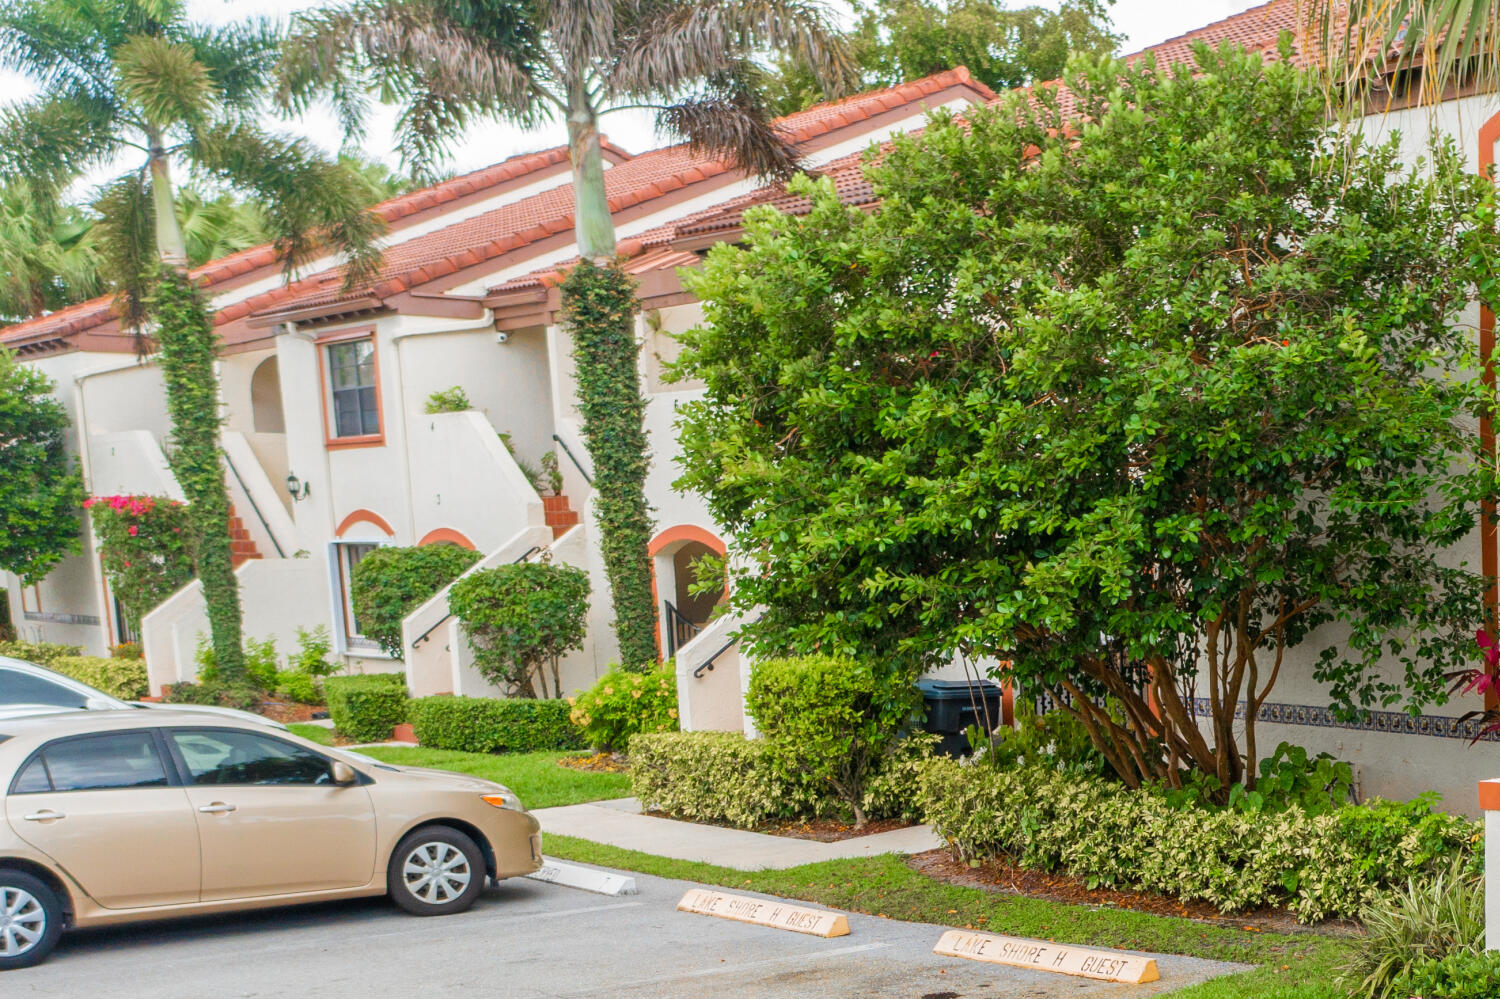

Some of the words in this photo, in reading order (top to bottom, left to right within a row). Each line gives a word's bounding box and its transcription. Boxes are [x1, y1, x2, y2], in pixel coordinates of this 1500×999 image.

[692, 894, 722, 912] LAKE
[729, 900, 763, 919] SHORE
[770, 907, 782, 921] H
[785, 911, 823, 930] GUEST
[953, 935, 991, 955] LAKE
[1000, 942, 1048, 964] SHORE
[1051, 951, 1068, 968] H
[1080, 956, 1129, 977] GUEST
